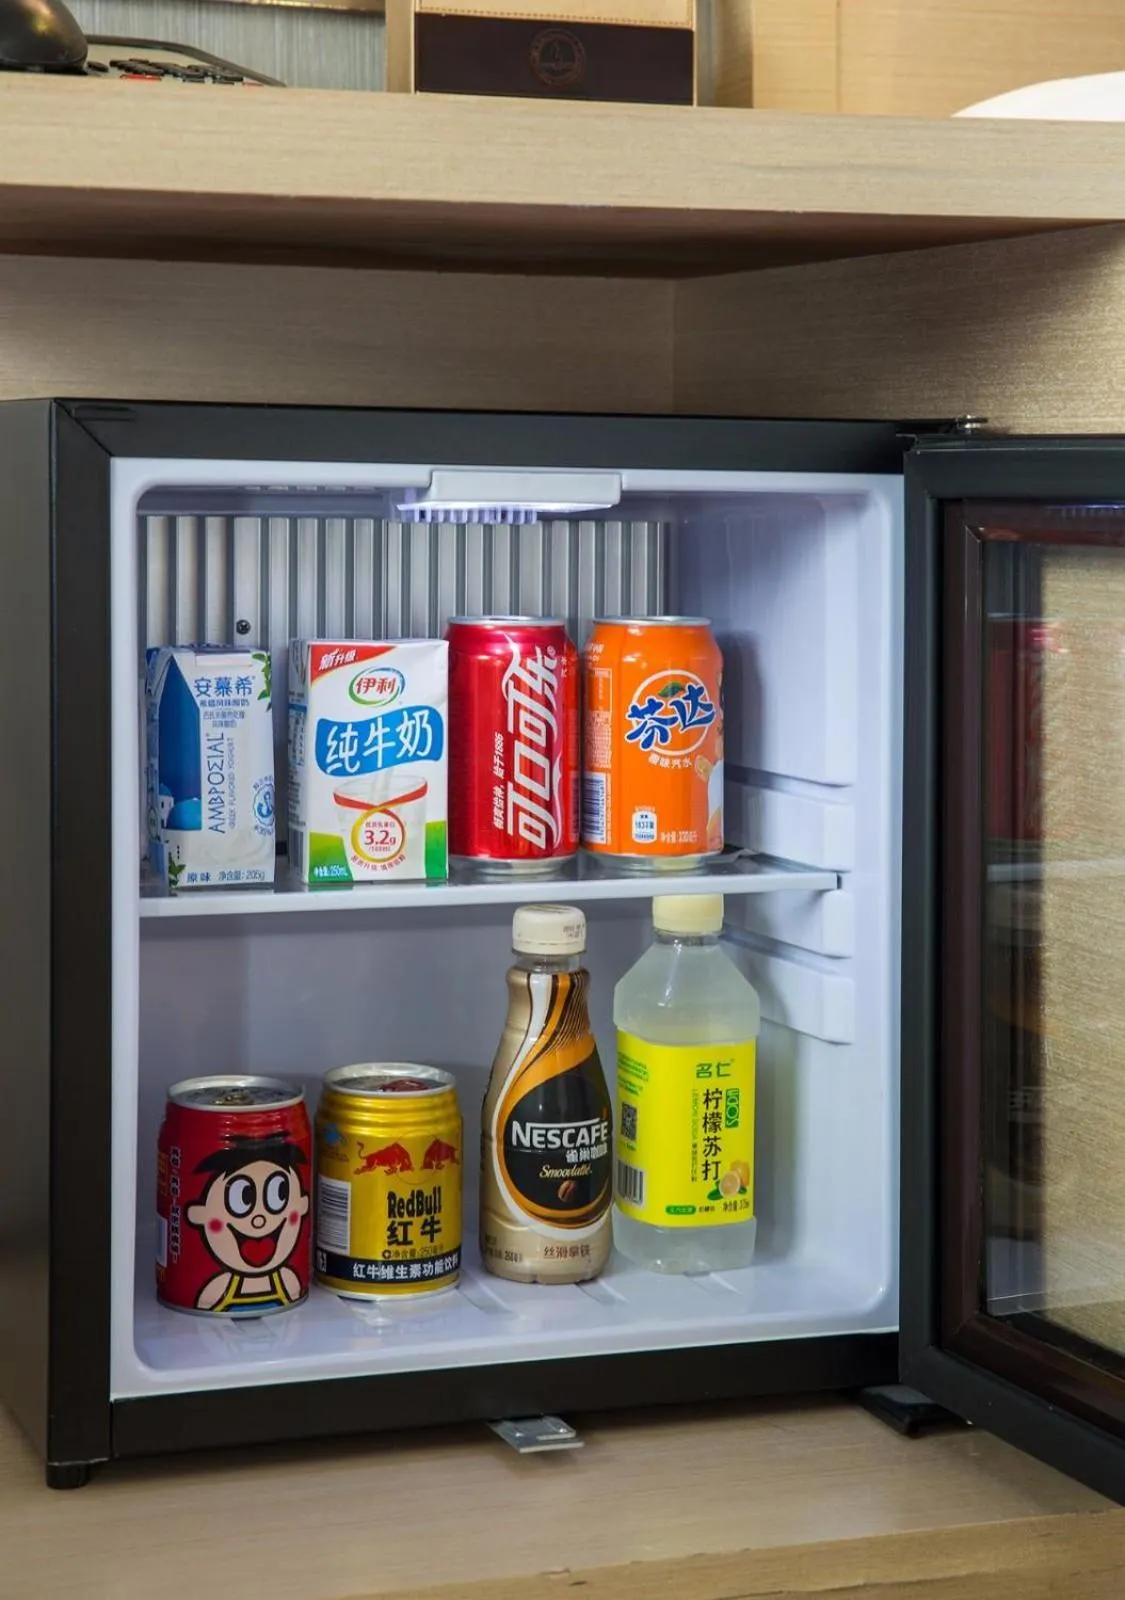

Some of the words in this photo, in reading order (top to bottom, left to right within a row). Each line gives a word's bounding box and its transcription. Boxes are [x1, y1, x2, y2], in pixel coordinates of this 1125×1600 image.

[319, 649, 356, 671] 新升级
[194, 676, 252, 698] 安慕希
[356, 677, 396, 694] 伊利
[625, 683, 716, 751] 芬达
[325, 709, 433, 773] 纯牛奶
[502, 633, 560, 850] 可口可乐
[364, 829, 396, 846] 3.2g
[187, 871, 210, 883] 原味
[696, 1062, 731, 1078] 名仁
[702, 1088, 722, 1181] 柠檬苏打
[386, 1215, 442, 1246] 红牛
